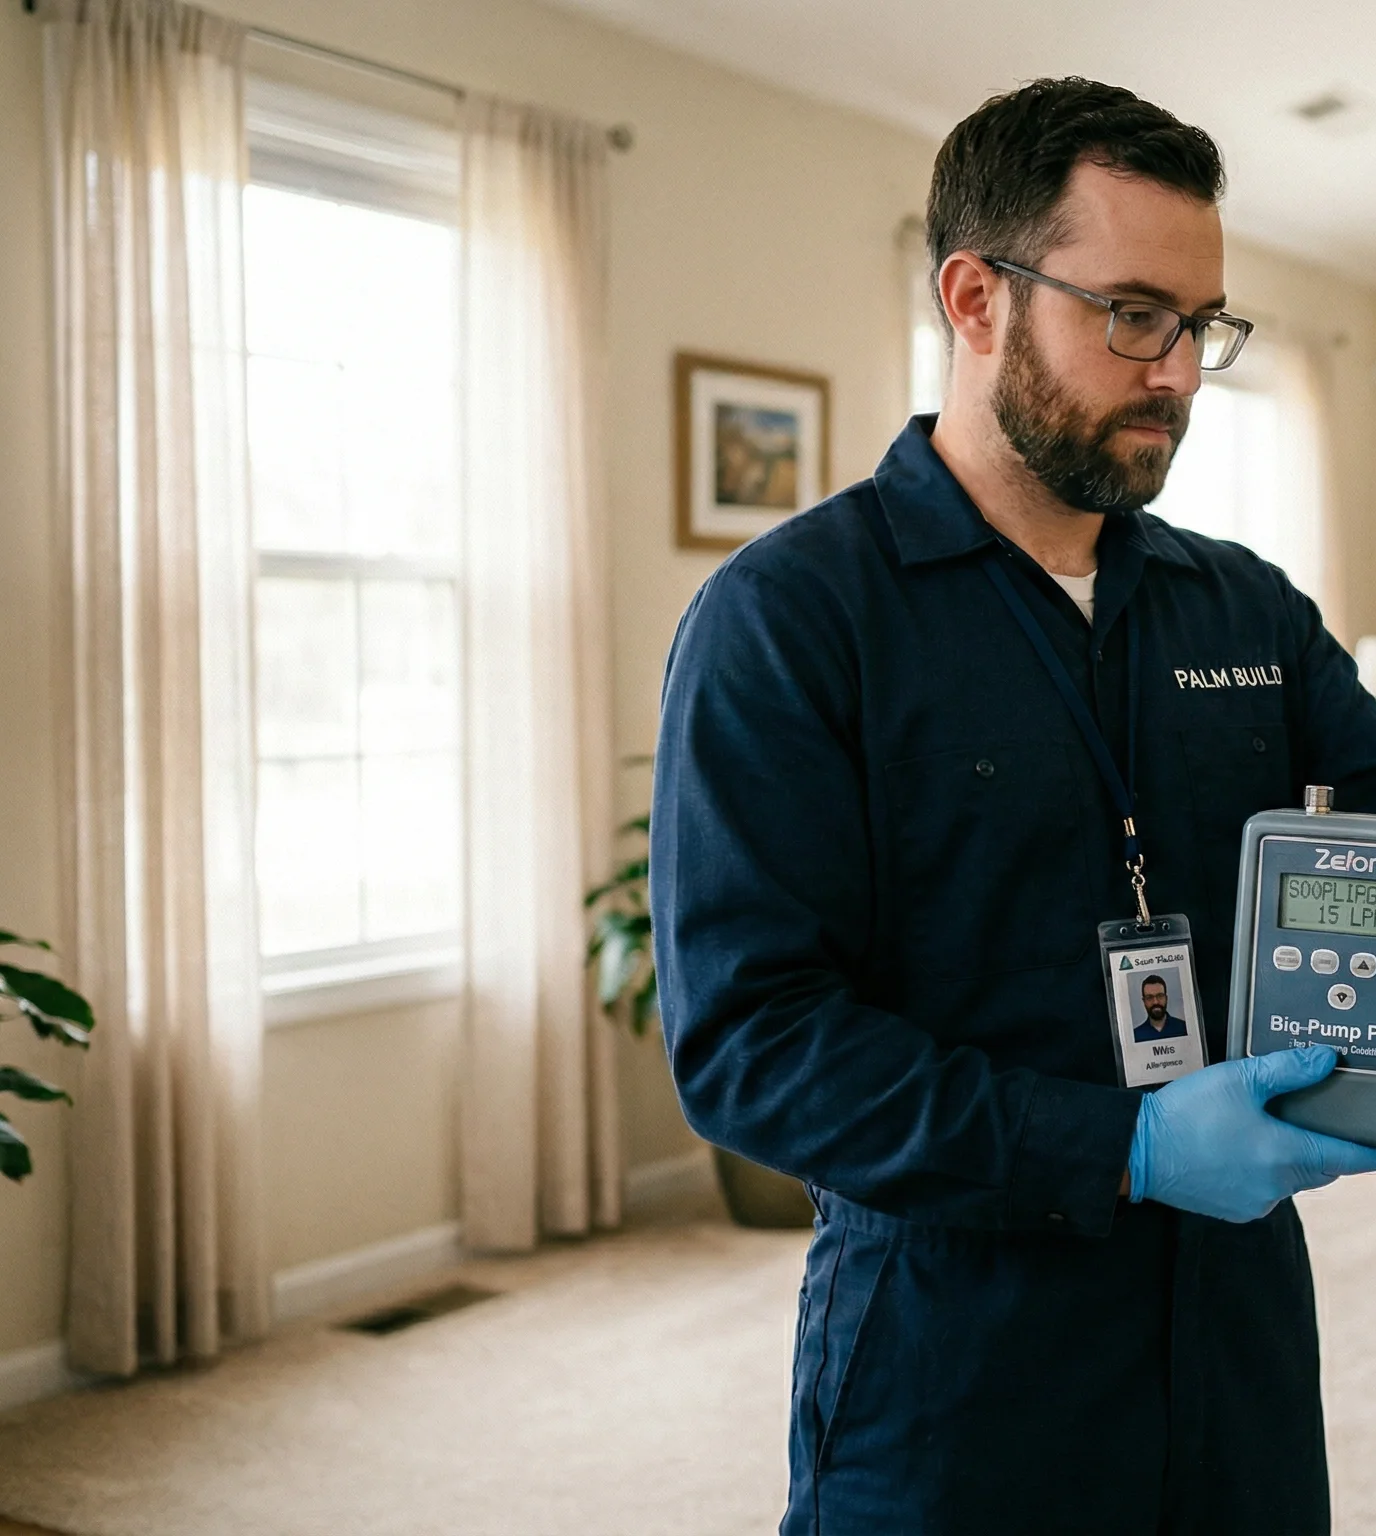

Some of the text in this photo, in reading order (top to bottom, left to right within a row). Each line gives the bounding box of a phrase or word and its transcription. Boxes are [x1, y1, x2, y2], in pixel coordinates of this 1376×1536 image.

[1174, 665, 1282, 689] PALM BUILD
[1318, 903, 1339, 925] 15
